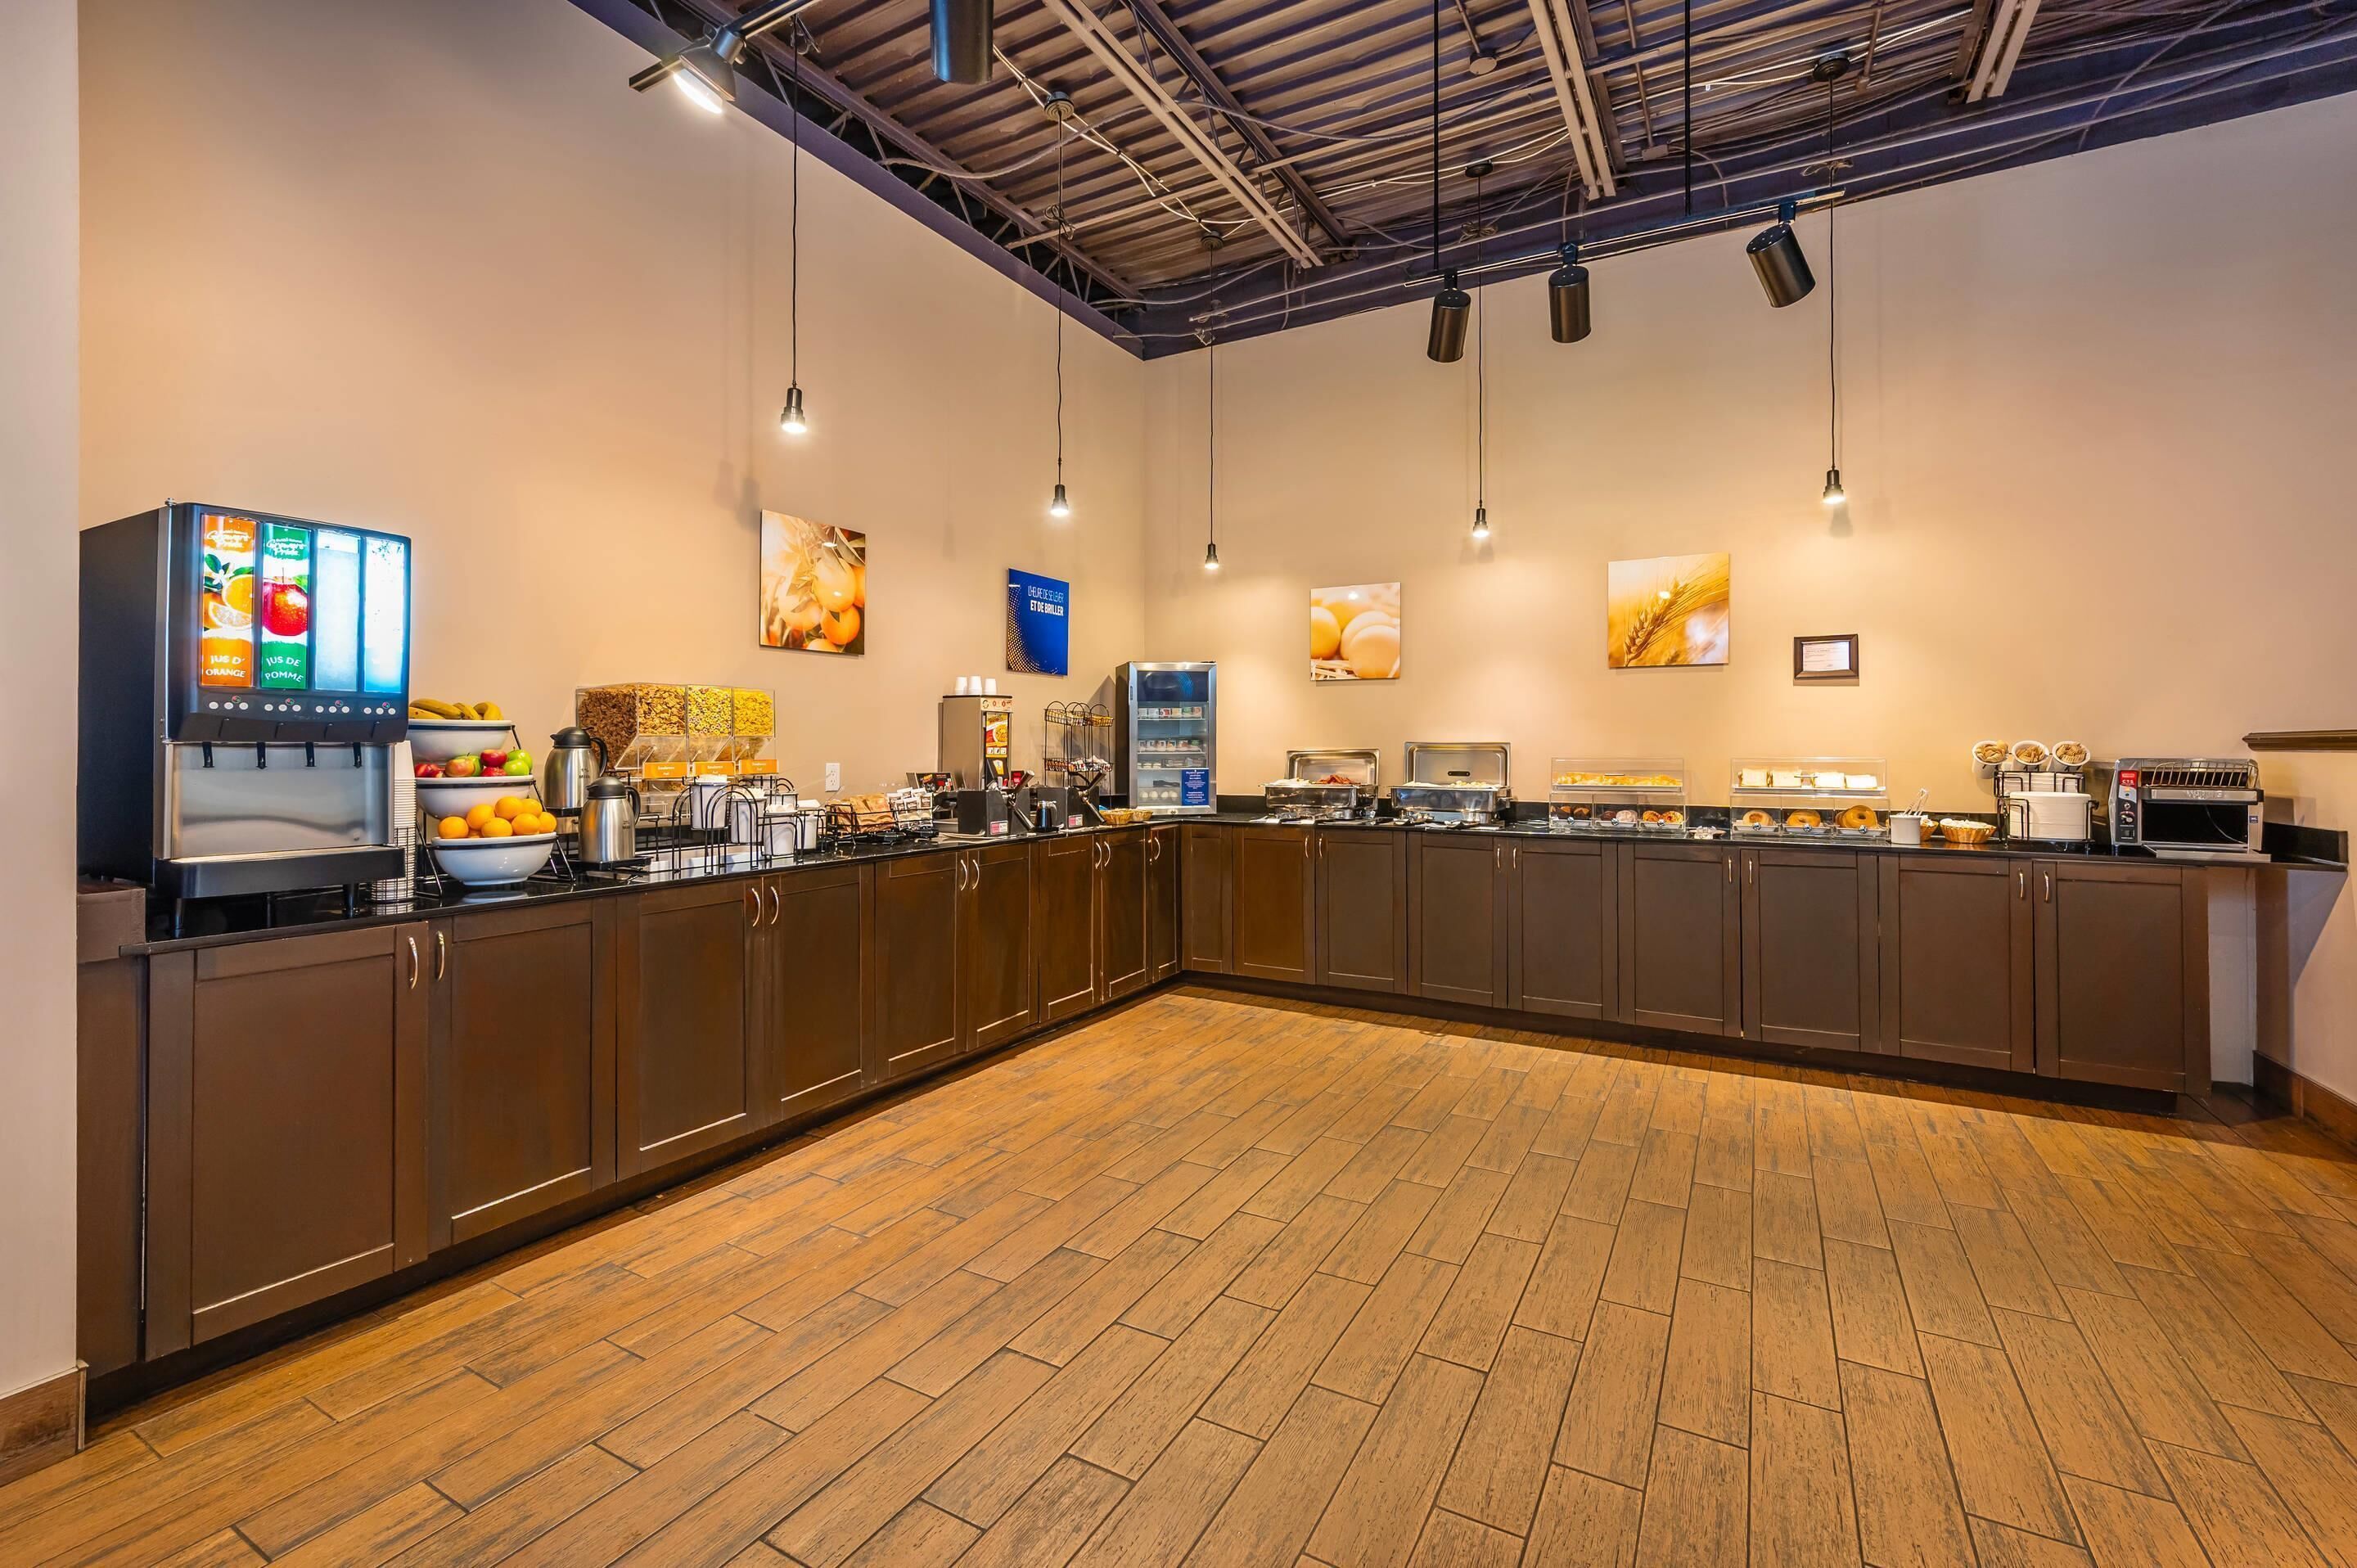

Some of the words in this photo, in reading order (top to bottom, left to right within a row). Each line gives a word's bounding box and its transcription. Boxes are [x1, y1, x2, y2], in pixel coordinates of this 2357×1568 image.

[1030, 600, 1037, 611] ET
[1038, 602, 1043, 612] DE
[1045, 602, 1063, 615] BRILLER
[210, 655, 229, 665] JUS
[266, 656, 284, 666] JUS
[286, 657, 301, 667] DE
[205, 668, 246, 678] ORANGE
[264, 670, 304, 683] POMME
